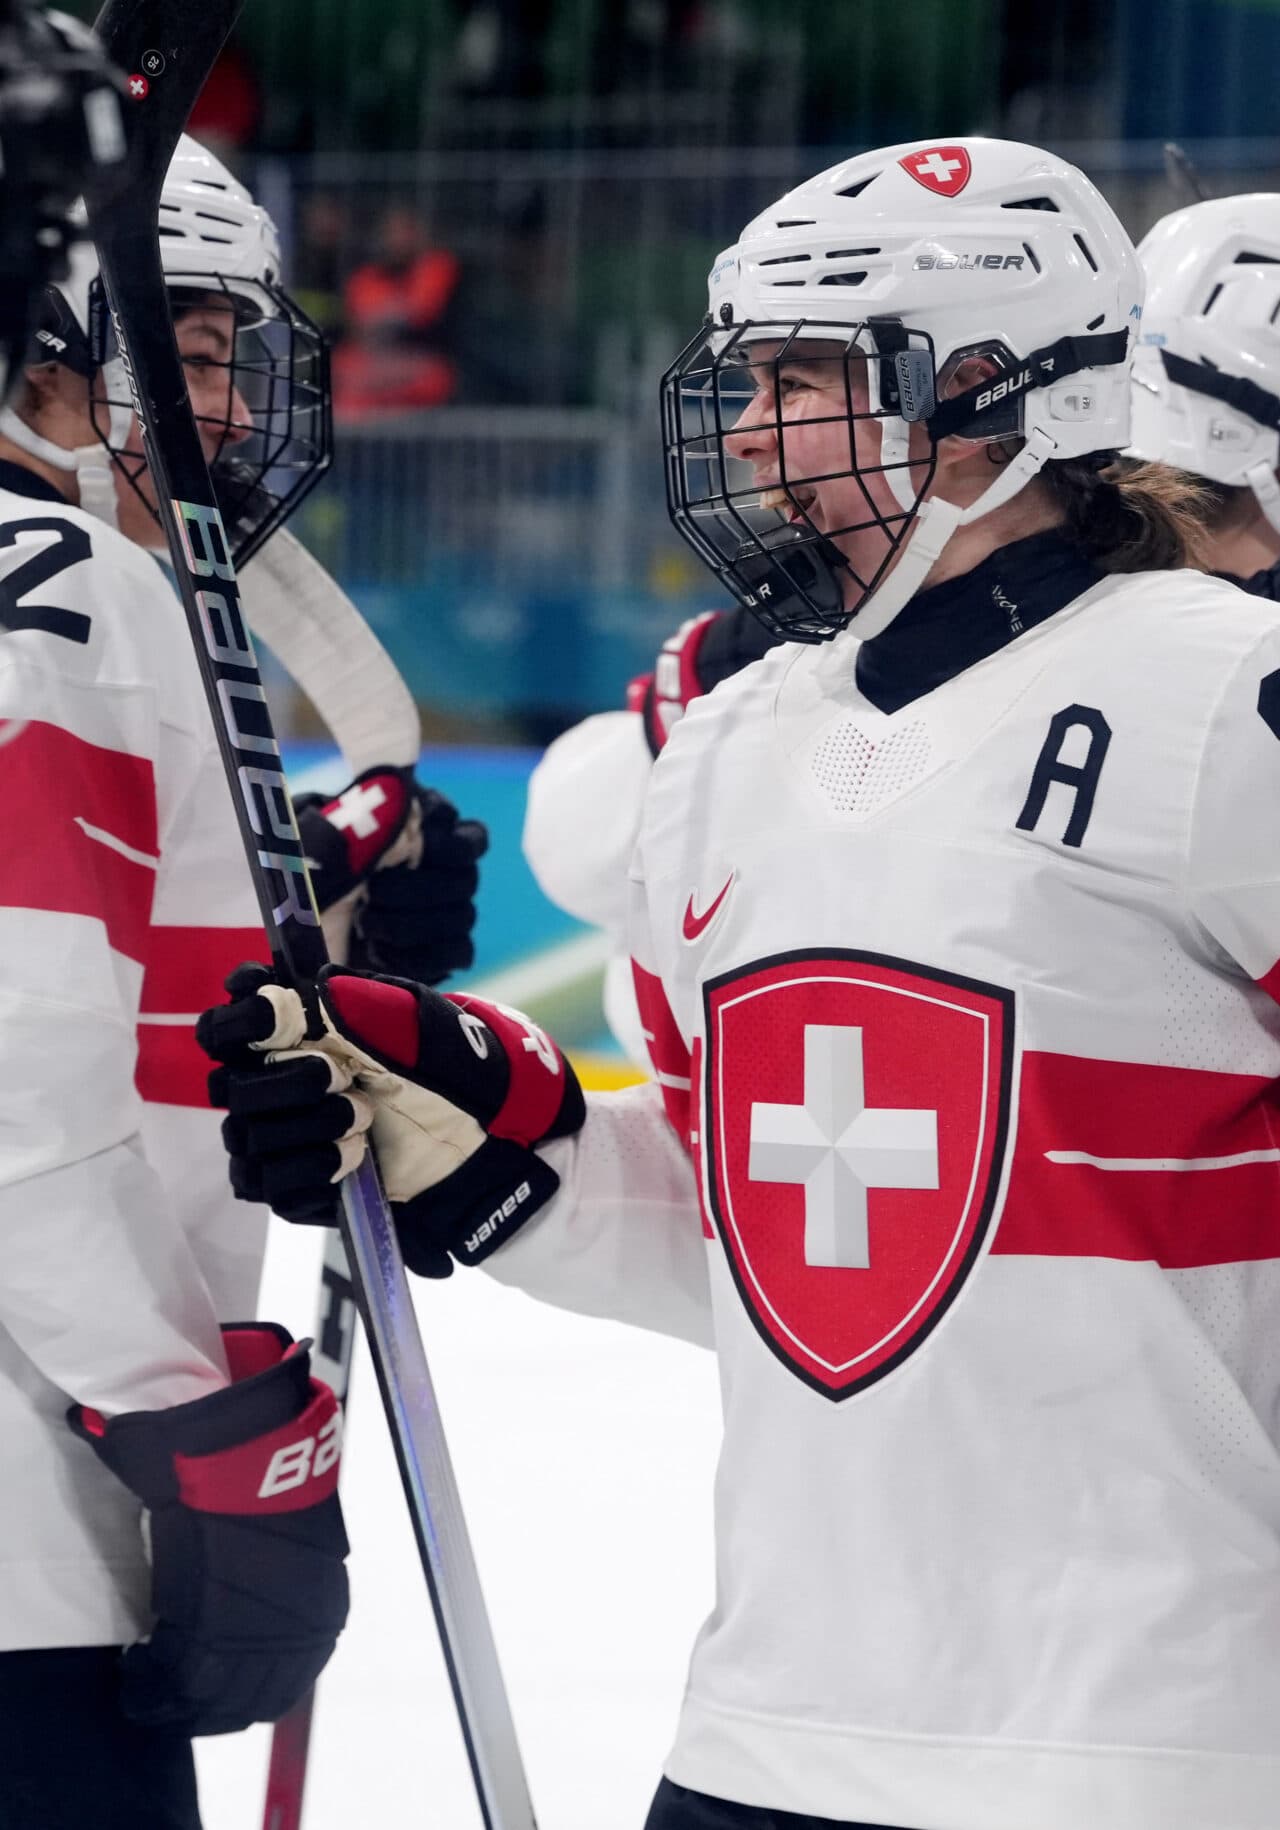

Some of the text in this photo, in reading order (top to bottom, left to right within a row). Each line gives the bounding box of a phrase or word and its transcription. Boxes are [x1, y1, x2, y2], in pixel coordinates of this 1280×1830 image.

[912, 254, 1025, 271] BAUER
[900, 356, 915, 412] BAUER
[170, 499, 321, 928] BAUER
[1015, 703, 1113, 848] A
[464, 1180, 533, 1253] BAUER
